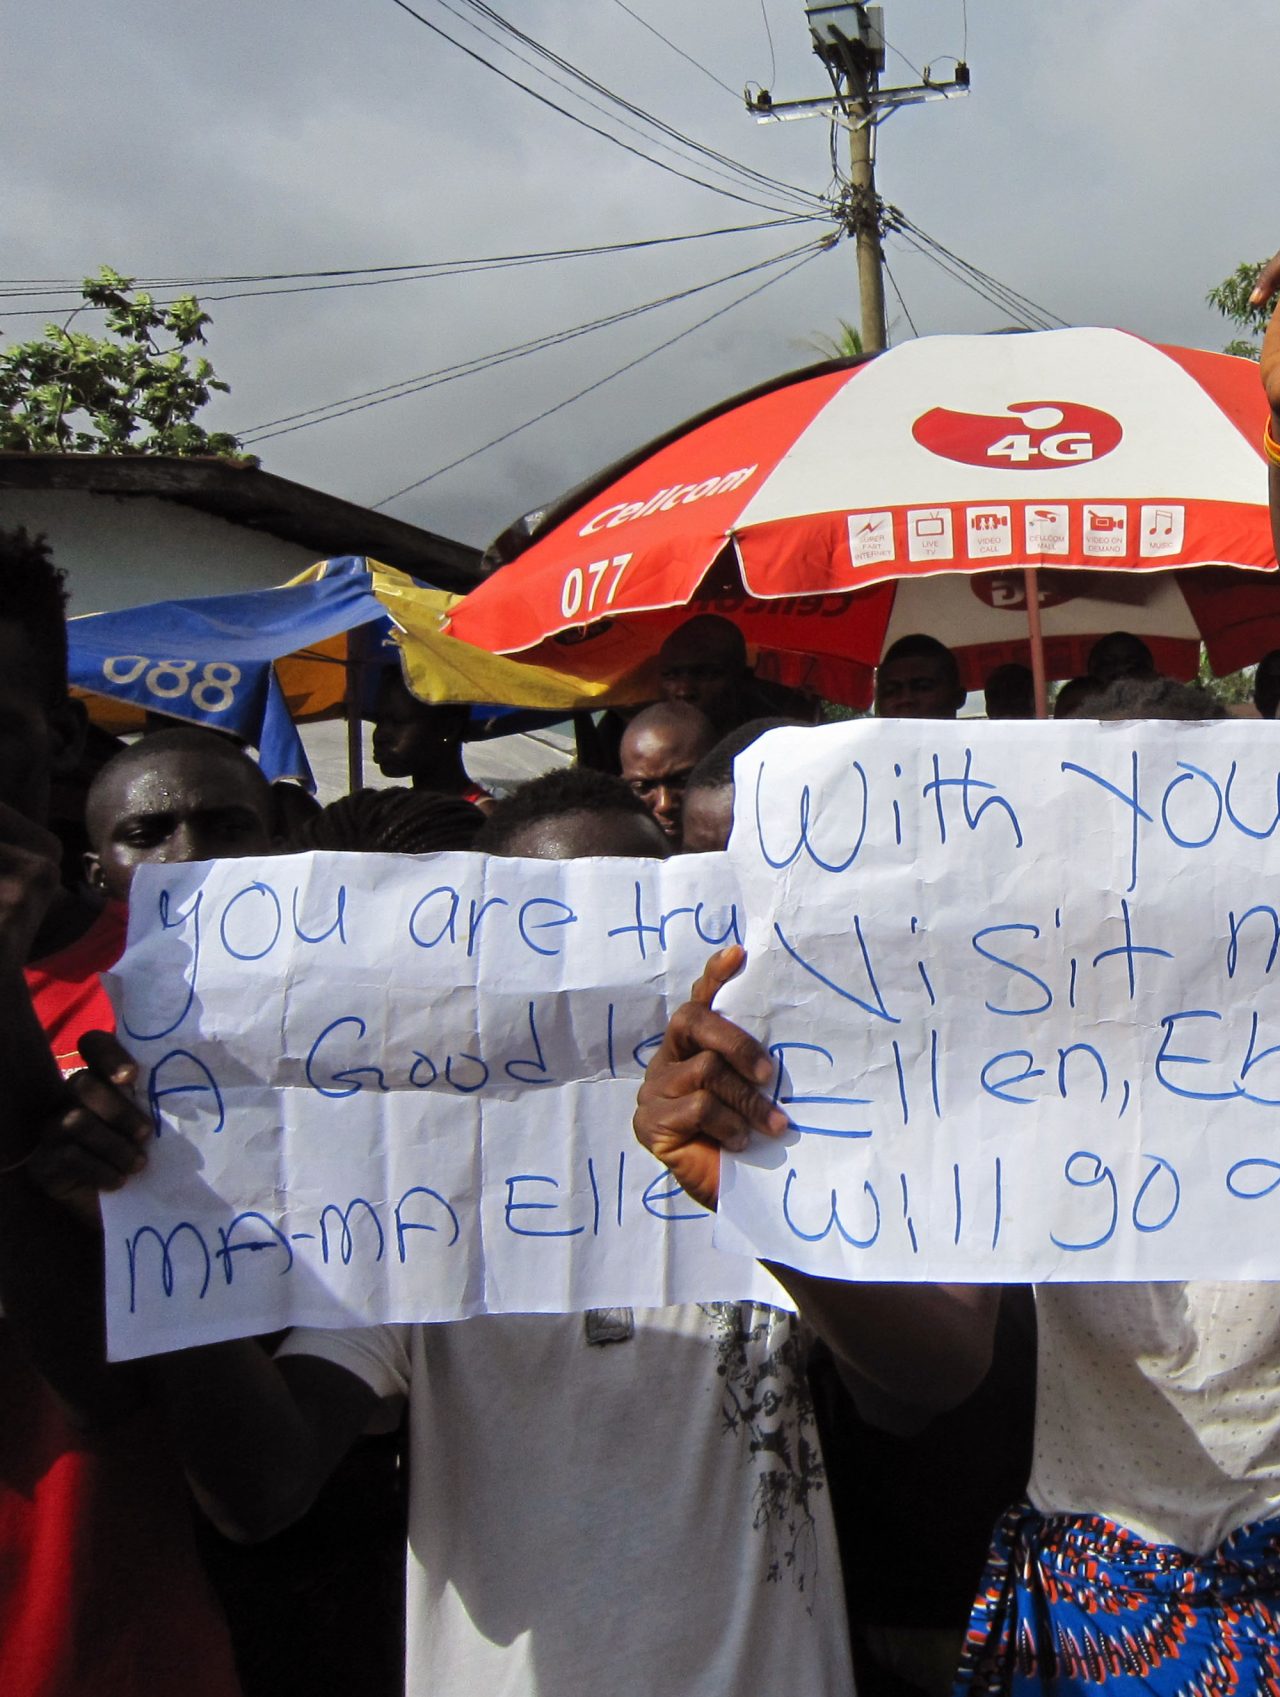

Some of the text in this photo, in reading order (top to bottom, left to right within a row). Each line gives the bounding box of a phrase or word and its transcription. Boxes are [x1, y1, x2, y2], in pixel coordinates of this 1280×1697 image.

[986, 432, 1093, 462] 4G
[578, 463, 759, 538] Cellcom
[921, 540, 939, 548] LIVE
[925, 548, 937, 556] TV
[976, 537, 1002, 546] VIDEO
[978, 545, 1000, 553] CALL
[1085, 536, 1123, 545] VIDEO ON
[1087, 544, 1121, 553] DEMAND
[1149, 541, 1174, 550] MUSIC
[560, 551, 634, 619] 077
[103, 655, 242, 713] 088
[755, 747, 1023, 873] With
[409, 885, 577, 957] are
[149, 1048, 227, 1139] A
[305, 1001, 550, 1099] Good
[1049, 1149, 1181, 1252] go
